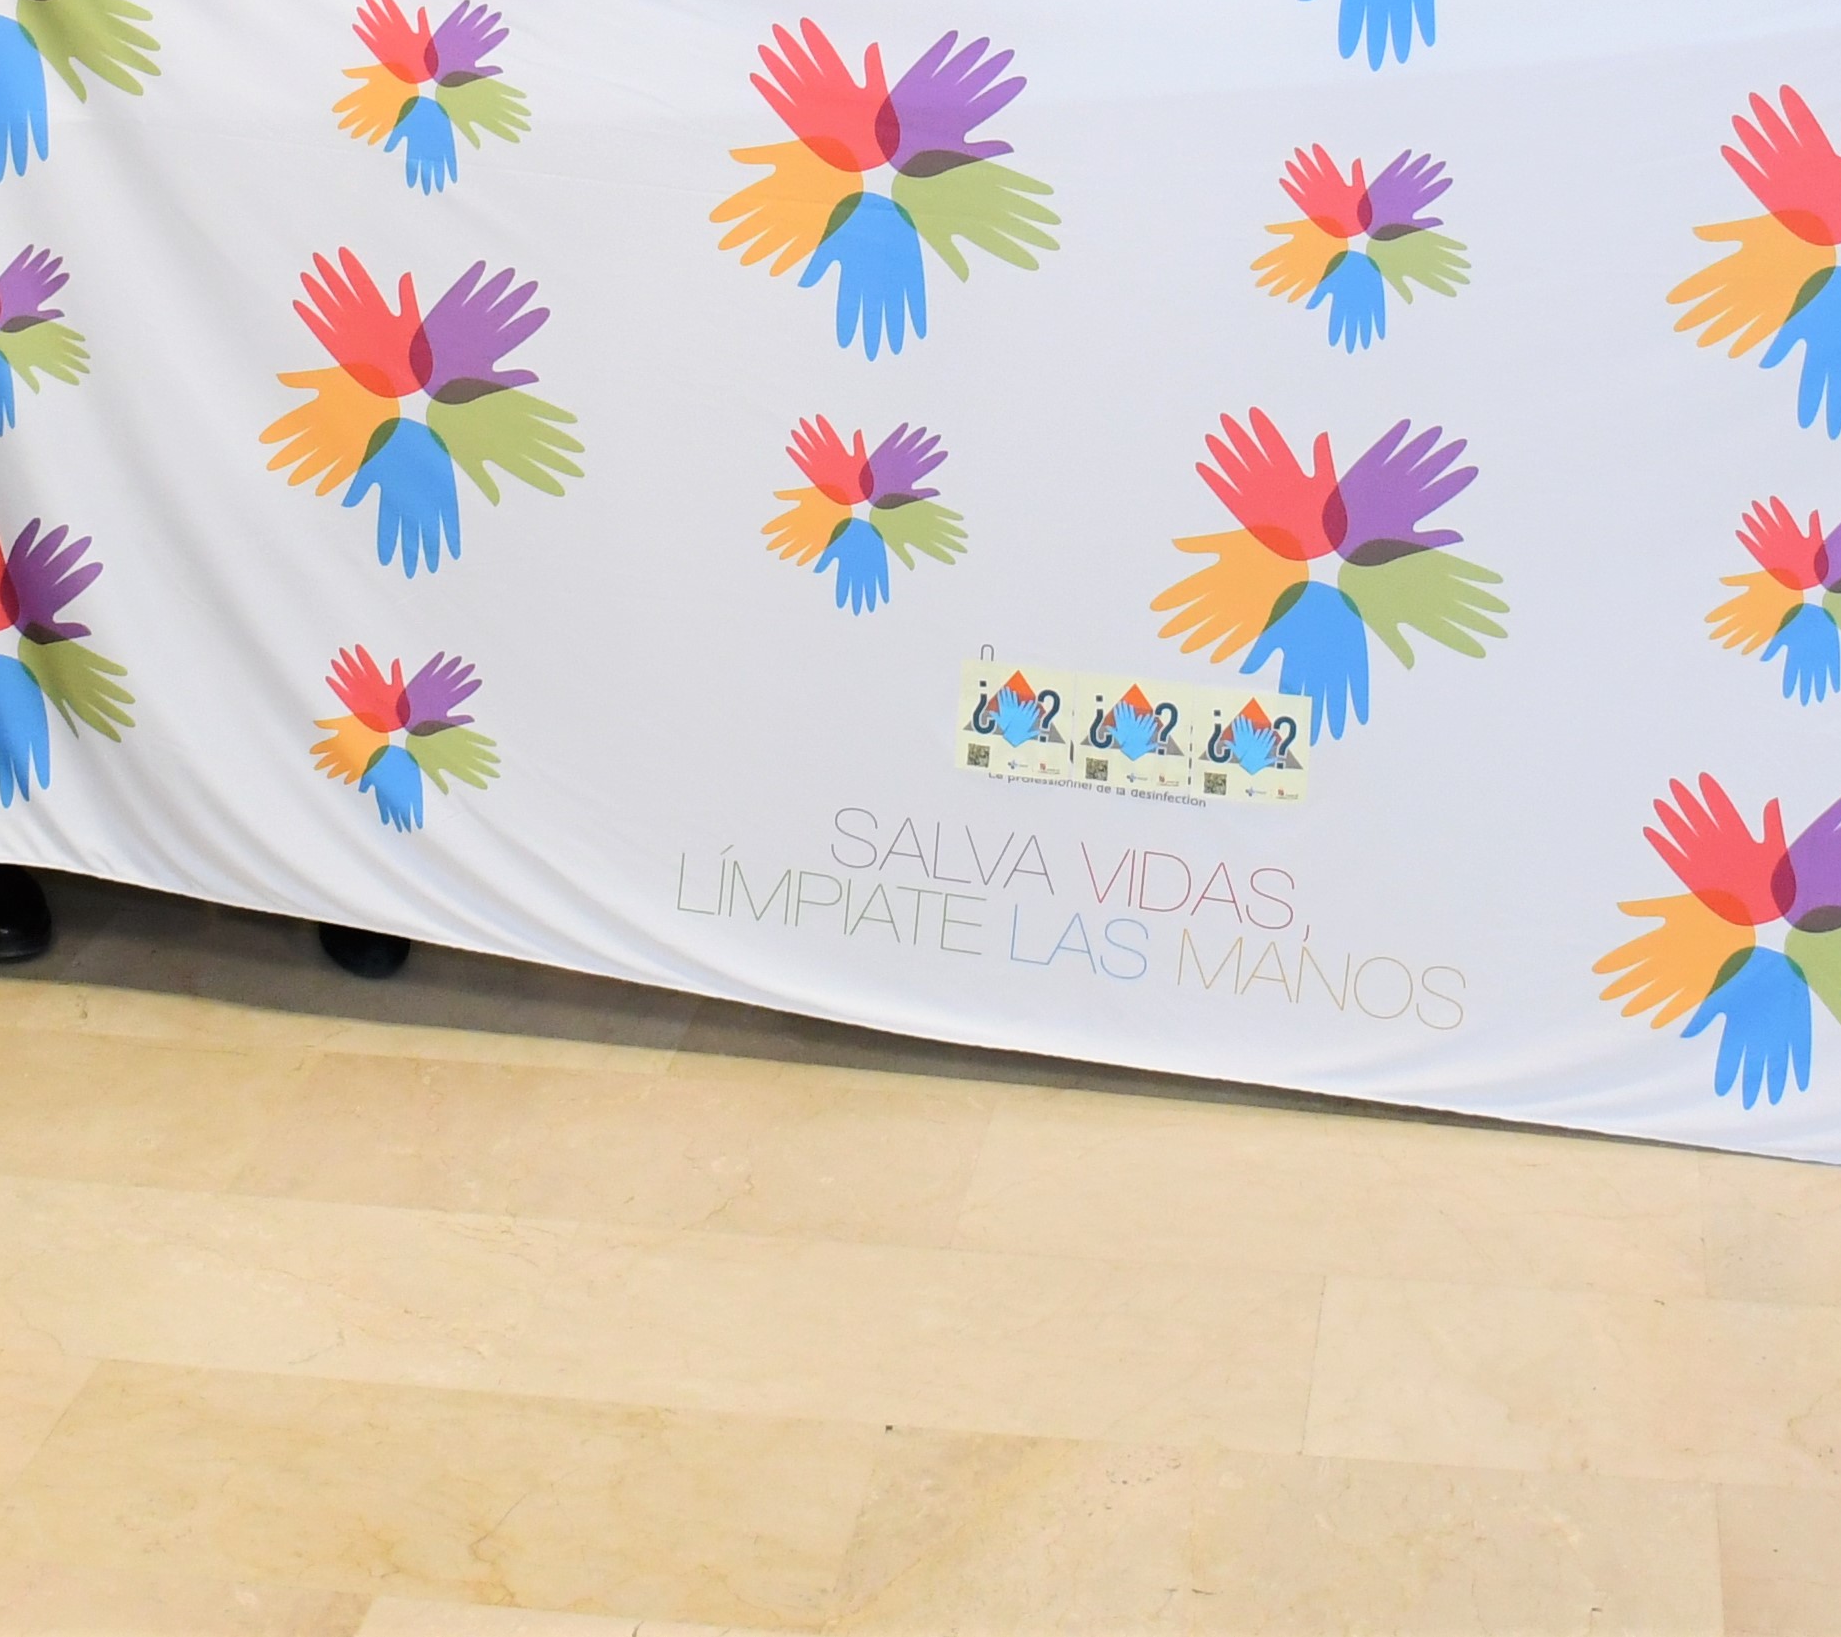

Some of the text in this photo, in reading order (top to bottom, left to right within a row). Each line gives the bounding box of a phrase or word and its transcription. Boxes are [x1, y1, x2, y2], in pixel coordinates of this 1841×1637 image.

[677, 844, 1467, 1030] LÍMPIATE LAS MANOS
[831, 807, 1310, 942] SALVA VIDAS,
